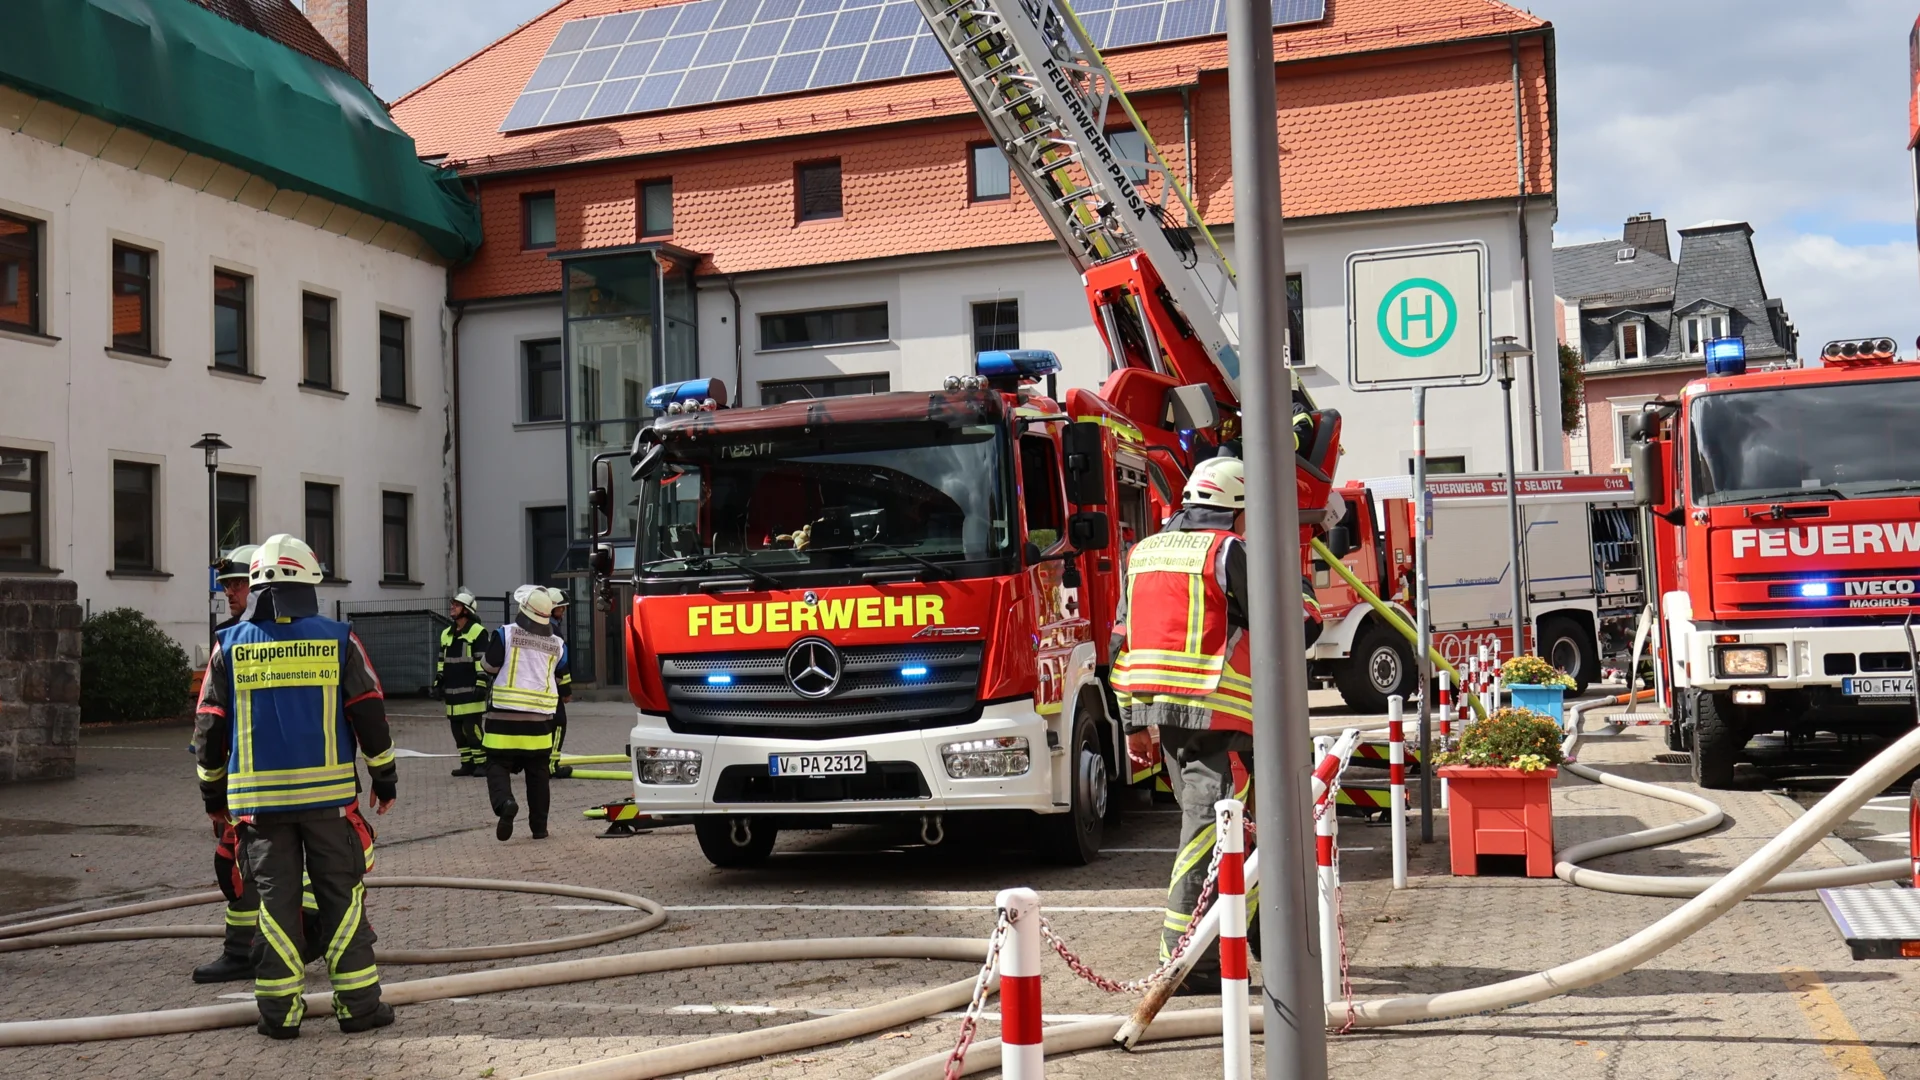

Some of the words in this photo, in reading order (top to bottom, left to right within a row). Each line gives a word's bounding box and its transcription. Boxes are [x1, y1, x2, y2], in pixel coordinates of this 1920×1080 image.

[1042, 58, 1112, 164] FEUERWEHR
[1107, 163, 1147, 221] PAUSA
[1401, 295, 1433, 340] H
[1491, 480, 1521, 492] STAT
[1524, 479, 1563, 491] SELBITZ
[1610, 479, 1624, 488] 112
[1130, 556, 1147, 569] Stadt
[1148, 555, 1202, 567] Schauenstein
[1844, 580, 1915, 596] IVECO
[1849, 598, 1910, 608] MAGIRUS
[688, 594, 945, 637] FEUERWEHR
[512, 637, 541, 650] FEUERWEHR
[235, 643, 336, 663] Gruppenführer
[237, 670, 258, 684] Stadt
[261, 668, 317, 682] Schauenstein
[319, 669, 338, 680] 40/1
[1852, 680, 1872, 693] HO
[1882, 679, 1901, 693] FW
[779, 757, 790, 773] V
